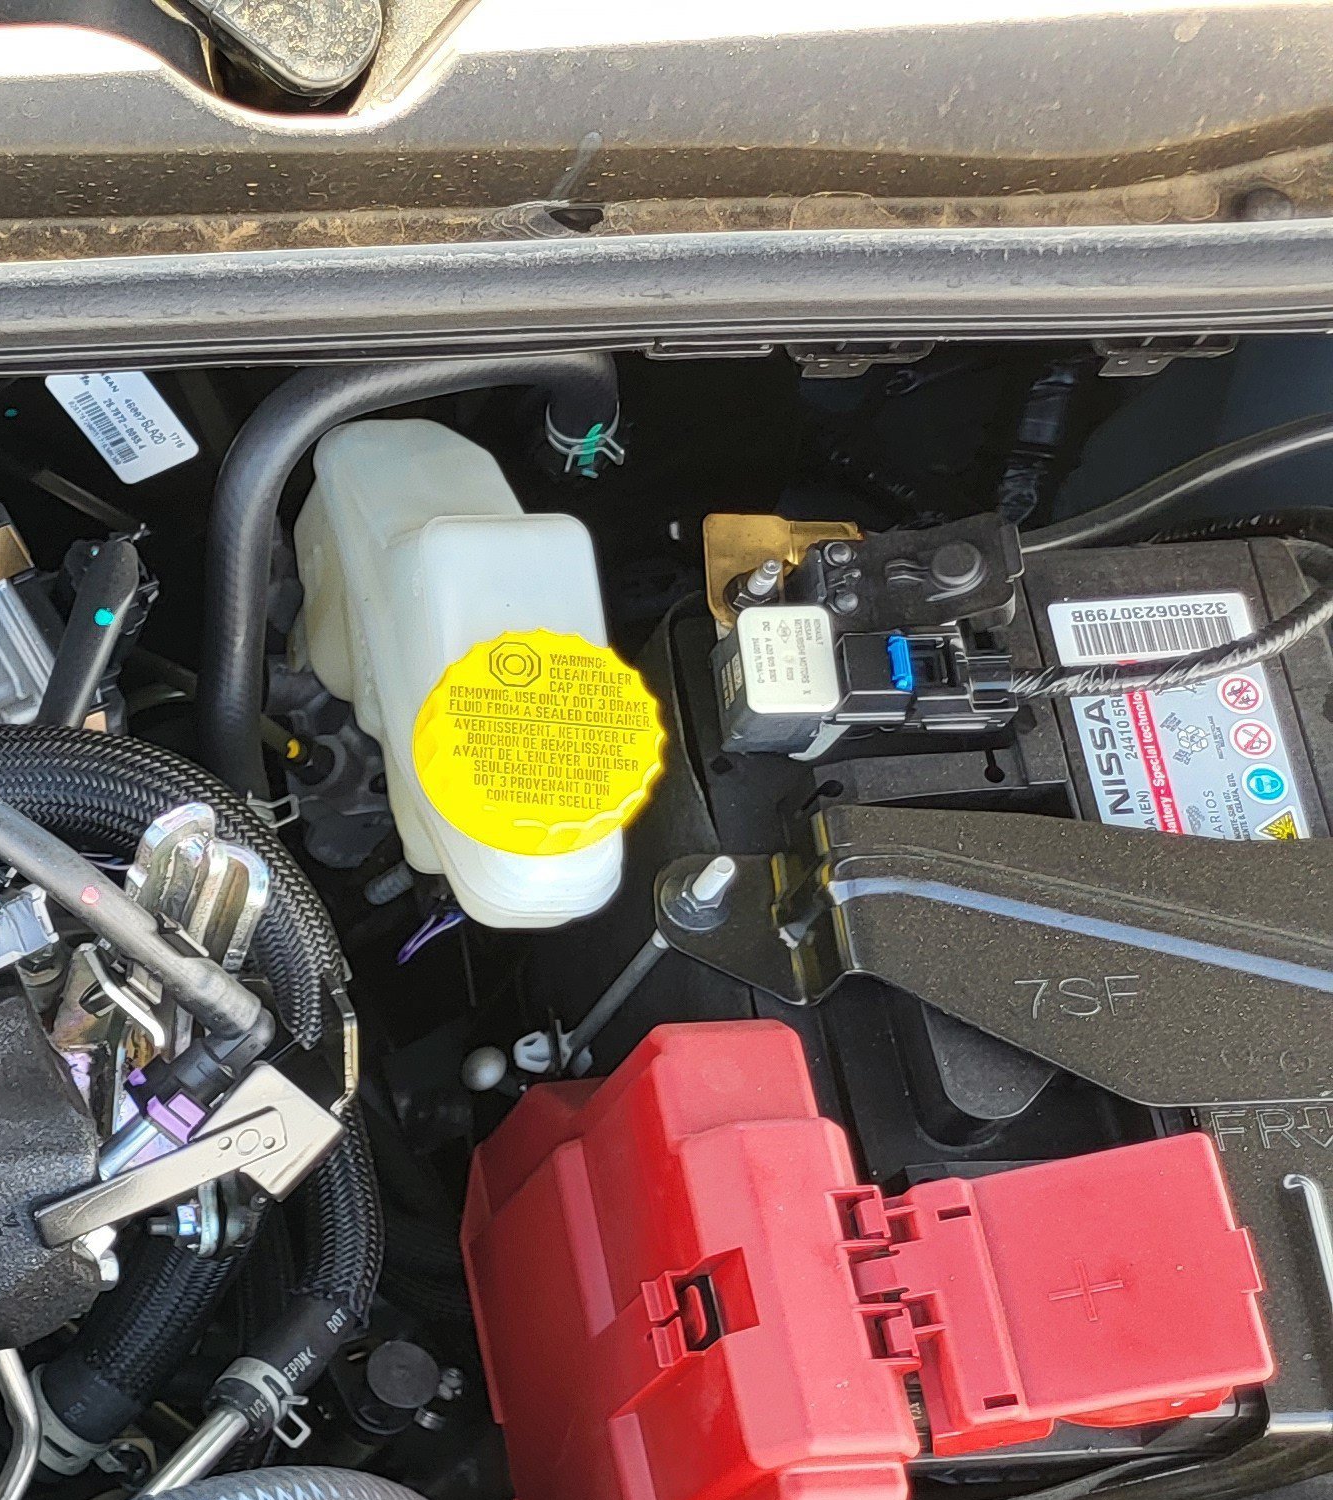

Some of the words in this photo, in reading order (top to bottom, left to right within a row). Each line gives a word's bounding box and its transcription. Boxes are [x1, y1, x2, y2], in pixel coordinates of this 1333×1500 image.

[1072, 602, 1228, 623] 323606230799B
[763, 622, 770, 631] DC
[550, 653, 606, 669] WARNING:
[549, 668, 588, 681] CLEAN
[591, 672, 632, 685] FILLER
[550, 681, 572, 693] CAP
[579, 683, 622, 698] BEFORE
[449, 699, 482, 712] FLUID
[487, 703, 519, 715] FROM
[523, 706, 531, 717] A
[536, 708, 582, 721] SEALED
[585, 711, 653, 728] CONTAINER.
[515, 692, 537, 704] USE
[539, 692, 569, 706] ONLY
[572, 696, 593, 709] DOT
[598, 699, 606, 710] 3
[609, 699, 648, 714] BRAKE
[1135, 690, 1153, 742] technolo
[467, 733, 519, 745] BOUCHON
[523, 737, 537, 749] DE
[541, 739, 623, 756] REMPLISSAGE
[558, 725, 619, 743] NETTOYER
[622, 732, 636, 744] LE
[1116, 720, 1138, 760] 24410
[453, 745, 494, 760] AVANT
[498, 748, 513, 761] DE
[588, 754, 638, 771] UTILISER
[1084, 698, 1135, 815] NISSA
[474, 760, 542, 776] SEULEMENT
[548, 765, 563, 778] DU
[566, 767, 610, 782] LIQUIDE
[1146, 754, 1169, 787] Special
[474, 774, 495, 786] DOT
[500, 776, 507, 787] 3
[510, 777, 581, 793] PROVENANT
[487, 789, 554, 805] CONTENANT
[558, 796, 602, 810] SCELLE
[1136, 791, 1152, 815] (EN)
[1014, 975, 1140, 1020] 7SF
[1210, 1109, 1301, 1151] FR
[325, 1308, 347, 1334] DOT
